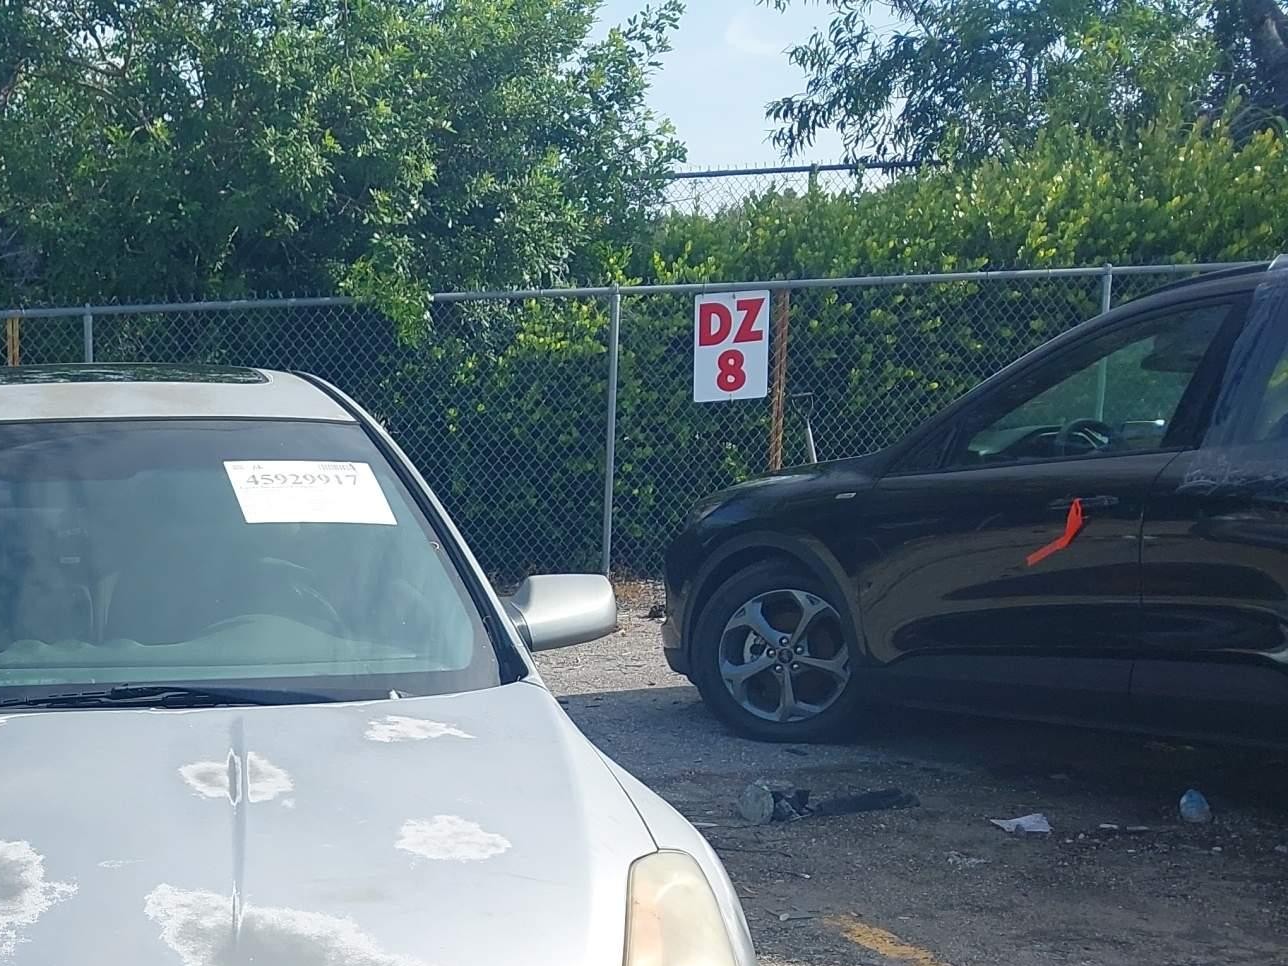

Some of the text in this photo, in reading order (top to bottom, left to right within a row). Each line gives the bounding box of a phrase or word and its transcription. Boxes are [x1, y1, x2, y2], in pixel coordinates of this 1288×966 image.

[699, 298, 765, 346] DZ
[717, 349, 746, 392] 8
[246, 473, 359, 486] 45929917
